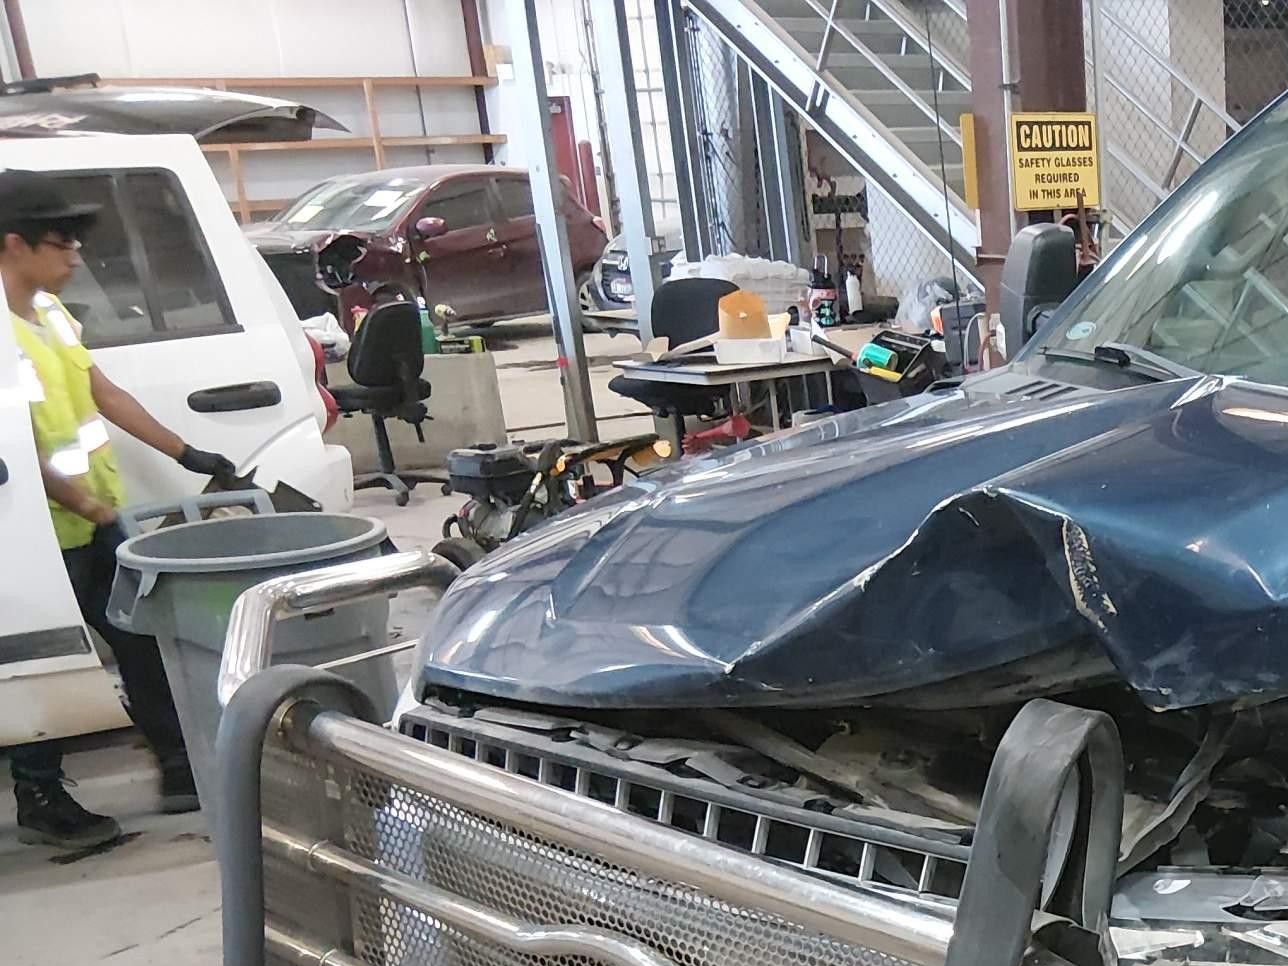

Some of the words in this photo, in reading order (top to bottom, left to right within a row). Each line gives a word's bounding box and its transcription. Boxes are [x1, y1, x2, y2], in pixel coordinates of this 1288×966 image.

[1020, 124, 1089, 148] CAUTION
[1018, 157, 1051, 168] SAFETY
[1054, 156, 1093, 167] GLASSES
[1035, 172, 1079, 184] REQUIRED
[1029, 189, 1038, 200] IN
[1041, 188, 1061, 200] THIS
[1064, 187, 1086, 198] AREA
